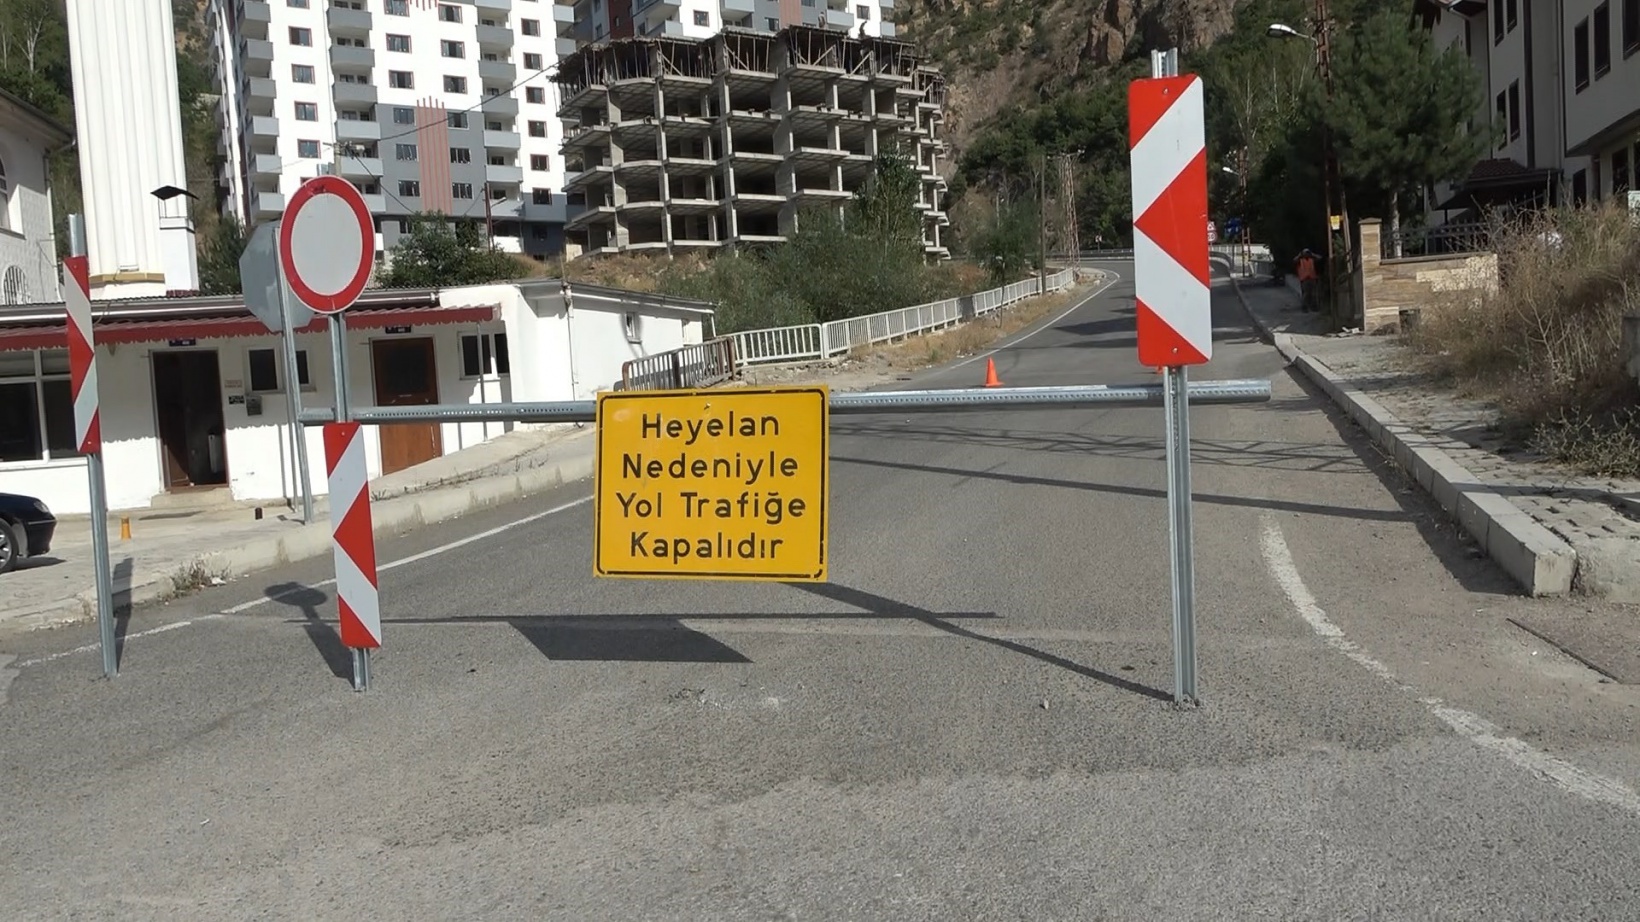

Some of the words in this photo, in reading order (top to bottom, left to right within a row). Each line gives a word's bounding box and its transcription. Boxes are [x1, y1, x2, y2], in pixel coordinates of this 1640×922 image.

[642, 410, 779, 446] Heyelan
[623, 450, 798, 485] Nedeniyle
[616, 491, 662, 518] Yol
[680, 491, 806, 525] Trafiğe
[631, 531, 784, 565] Kapalıdır
